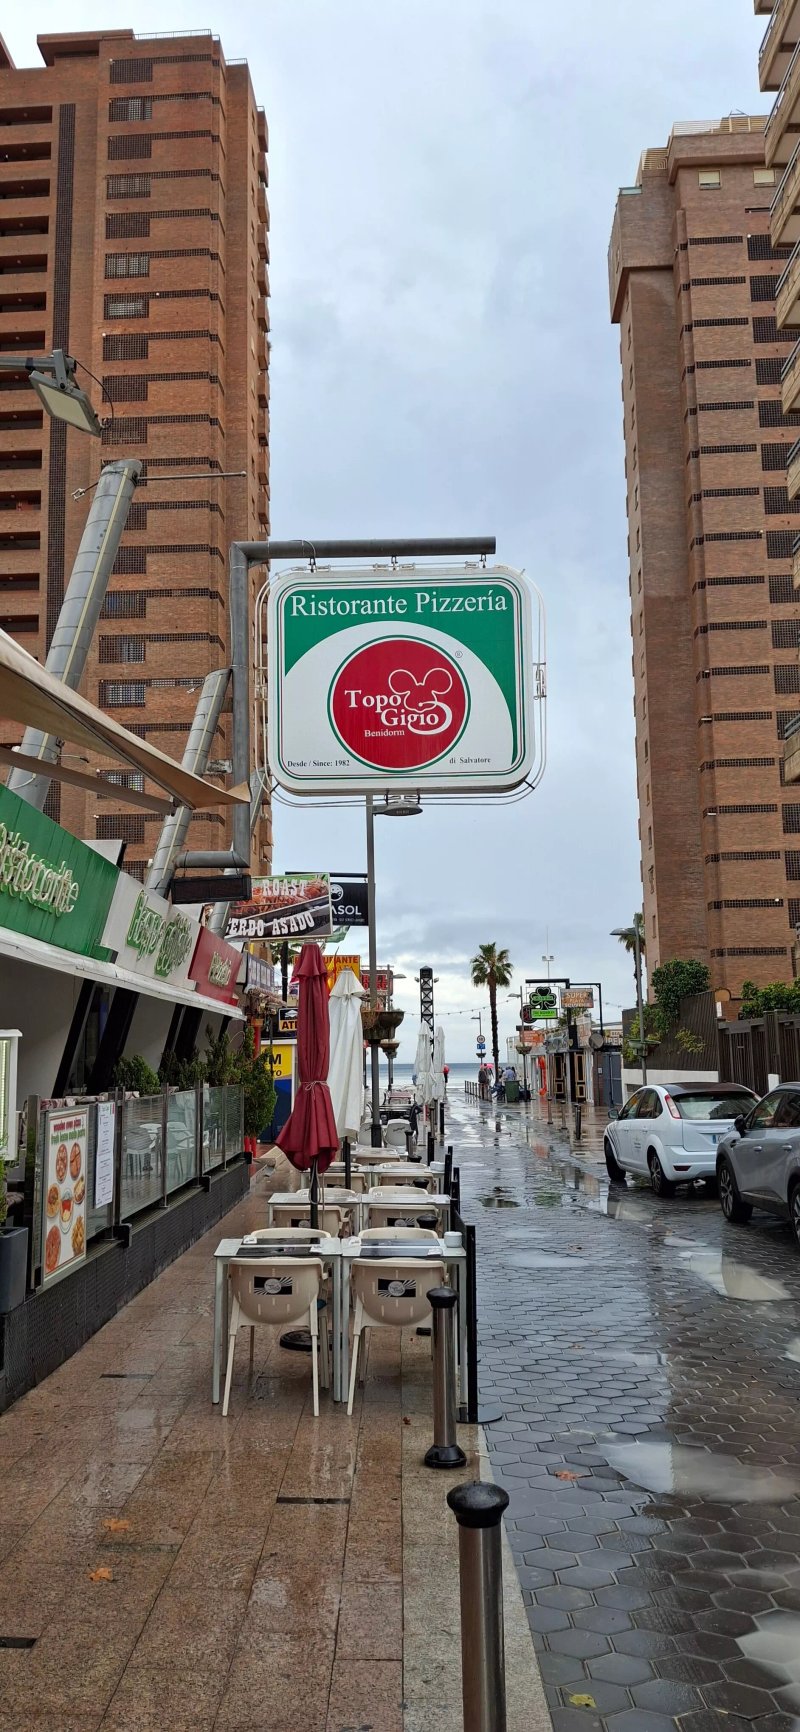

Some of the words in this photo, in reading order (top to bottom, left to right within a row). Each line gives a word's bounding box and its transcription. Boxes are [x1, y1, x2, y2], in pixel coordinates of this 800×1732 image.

[290, 594, 407, 617] Ristorante
[414, 589, 508, 613] Pizzería
[344, 689, 402, 713] Topo
[381, 708, 444, 730] Gigio
[364, 728, 405, 738] Benidorm
[459, 756, 491, 764] Salvatore
[262, 879, 307, 898] ROAST
[226, 916, 265, 937] ERDO
[272, 910, 315, 936] ASADO
